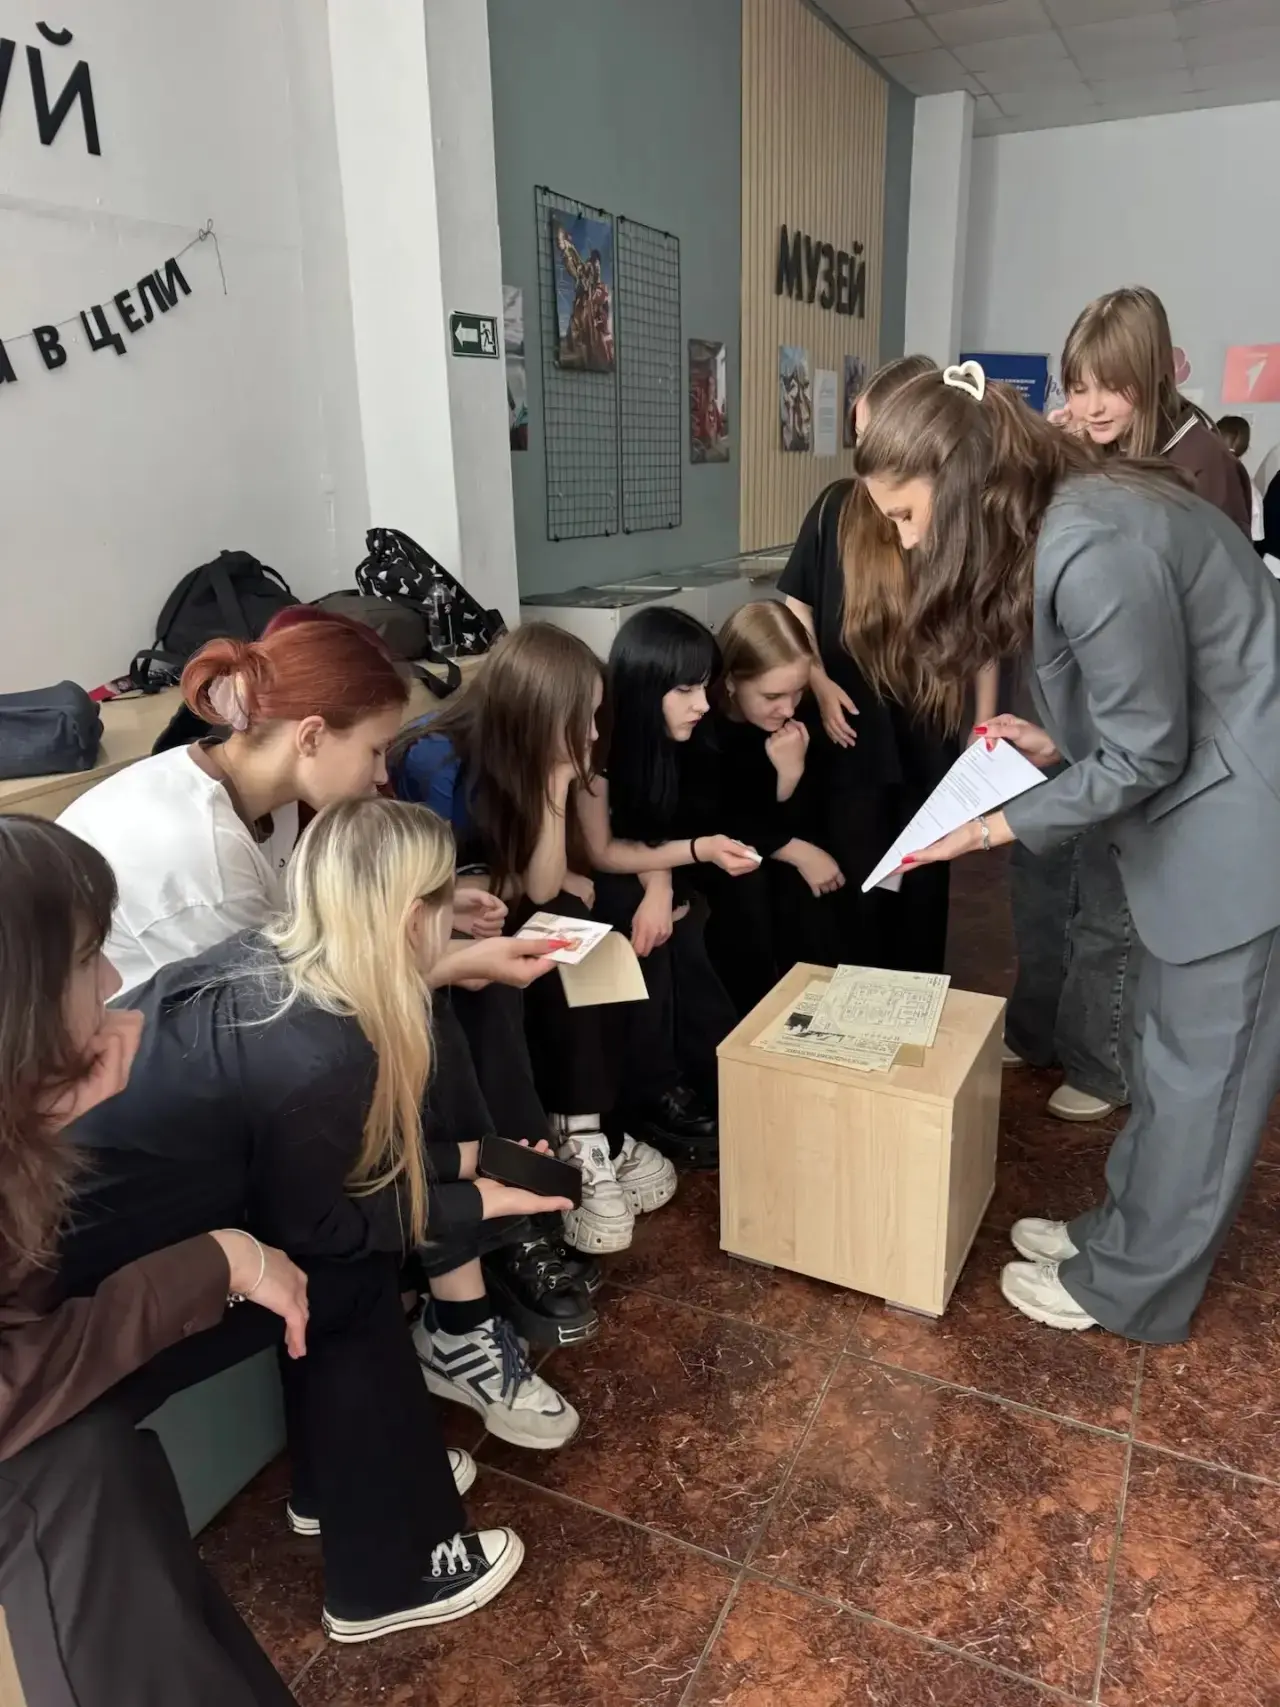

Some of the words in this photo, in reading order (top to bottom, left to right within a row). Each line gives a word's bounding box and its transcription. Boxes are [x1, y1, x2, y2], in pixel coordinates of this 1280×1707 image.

[32, 325, 67, 370] В
[80, 257, 192, 356] ЦЕЛИ
[775, 224, 867, 318] МУЗЕЙ
